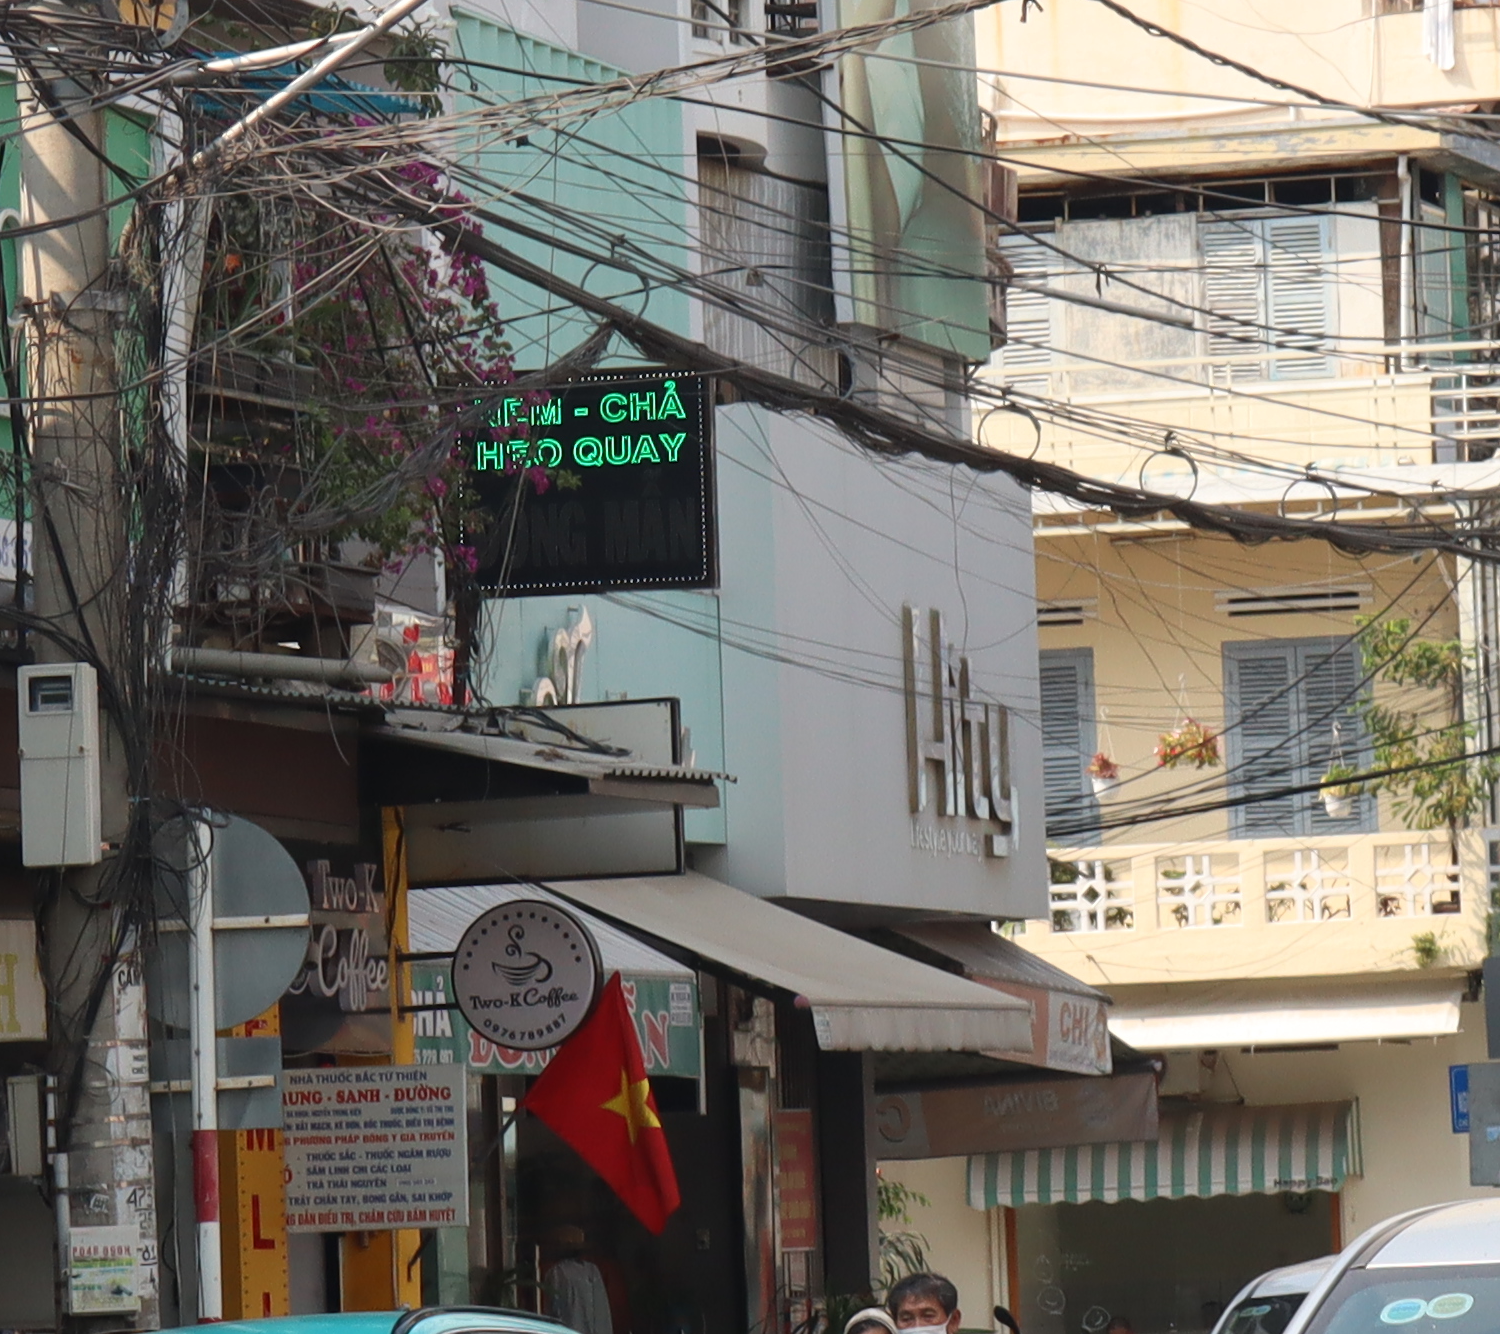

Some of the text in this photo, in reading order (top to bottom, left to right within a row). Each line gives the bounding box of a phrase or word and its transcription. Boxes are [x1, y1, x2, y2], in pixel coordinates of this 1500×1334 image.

[600, 380, 687, 423] CHẢ
[573, 433, 687, 468] QUAY
[902, 600, 1020, 858] Hity
[316, 859, 380, 913] Two-K
[289, 923, 390, 1012] Coffee
[469, 987, 580, 1010] Two-K Coffee
[290, 1074, 314, 1085] NHÀ
[336, 1089, 381, 1104] SANH
[394, 1083, 452, 1103] ĐƯỜNG
[400, 1132, 416, 1143] GIA
[352, 1164, 368, 1175] CHI
[411, 1192, 426, 1202] SAI
